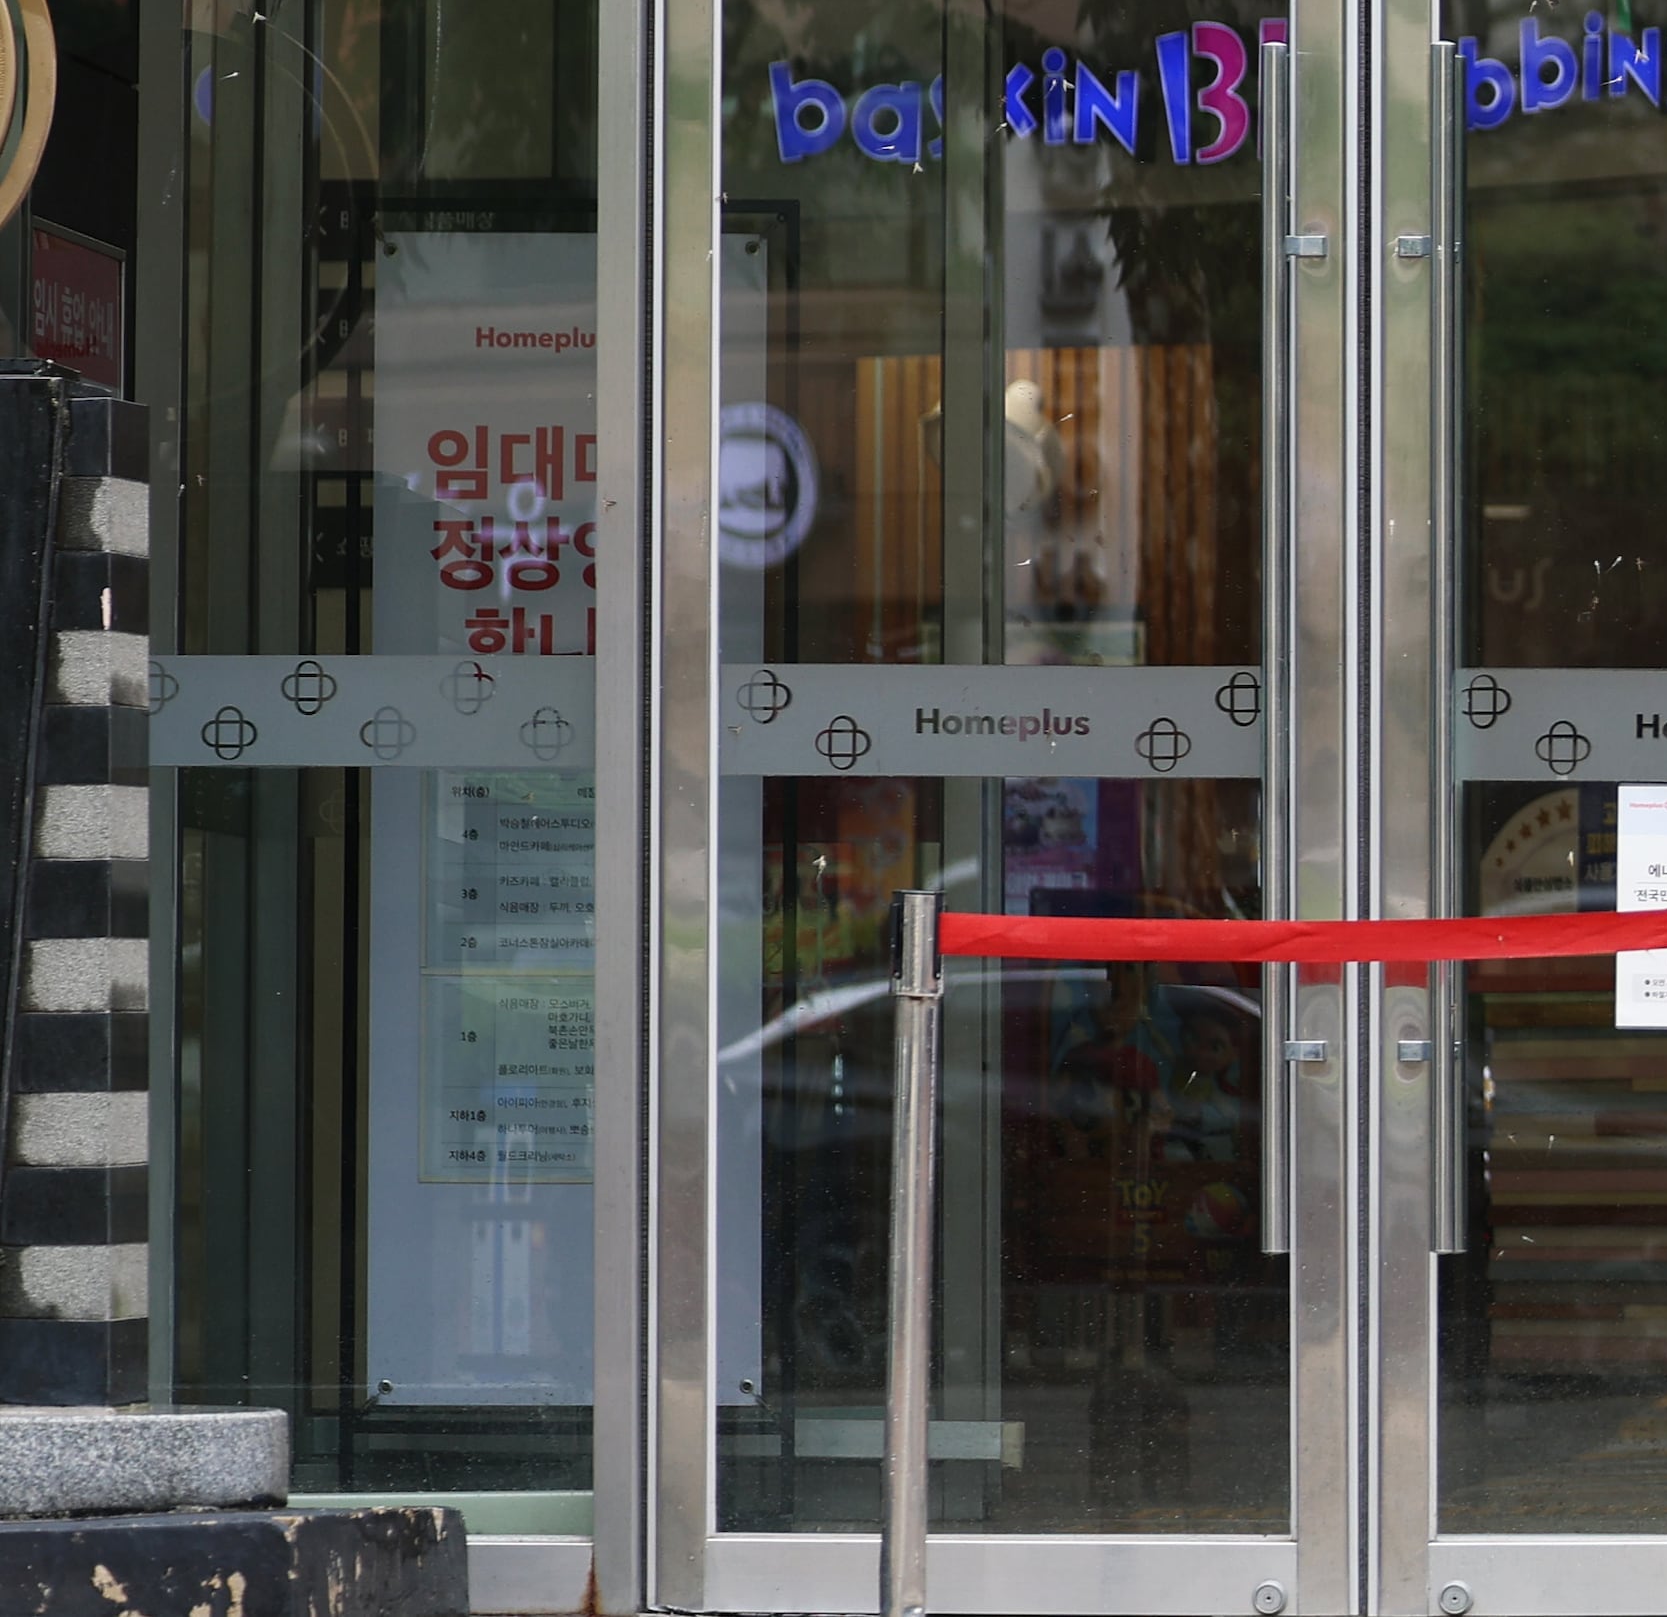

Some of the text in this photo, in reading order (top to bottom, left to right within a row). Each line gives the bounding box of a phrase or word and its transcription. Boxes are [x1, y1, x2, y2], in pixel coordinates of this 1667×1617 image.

[476, 327, 596, 353] Homeplu
[428, 425, 596, 500] 임대
[431, 516, 596, 591] 정상
[916, 708, 1090, 743] Homeplus
[461, 888, 478, 900] 3층
[460, 937, 477, 949] 2층
[461, 1032, 477, 1043] 1층
[450, 1110, 486, 1122] 지하1층
[449, 1150, 486, 1162] 지하4층
